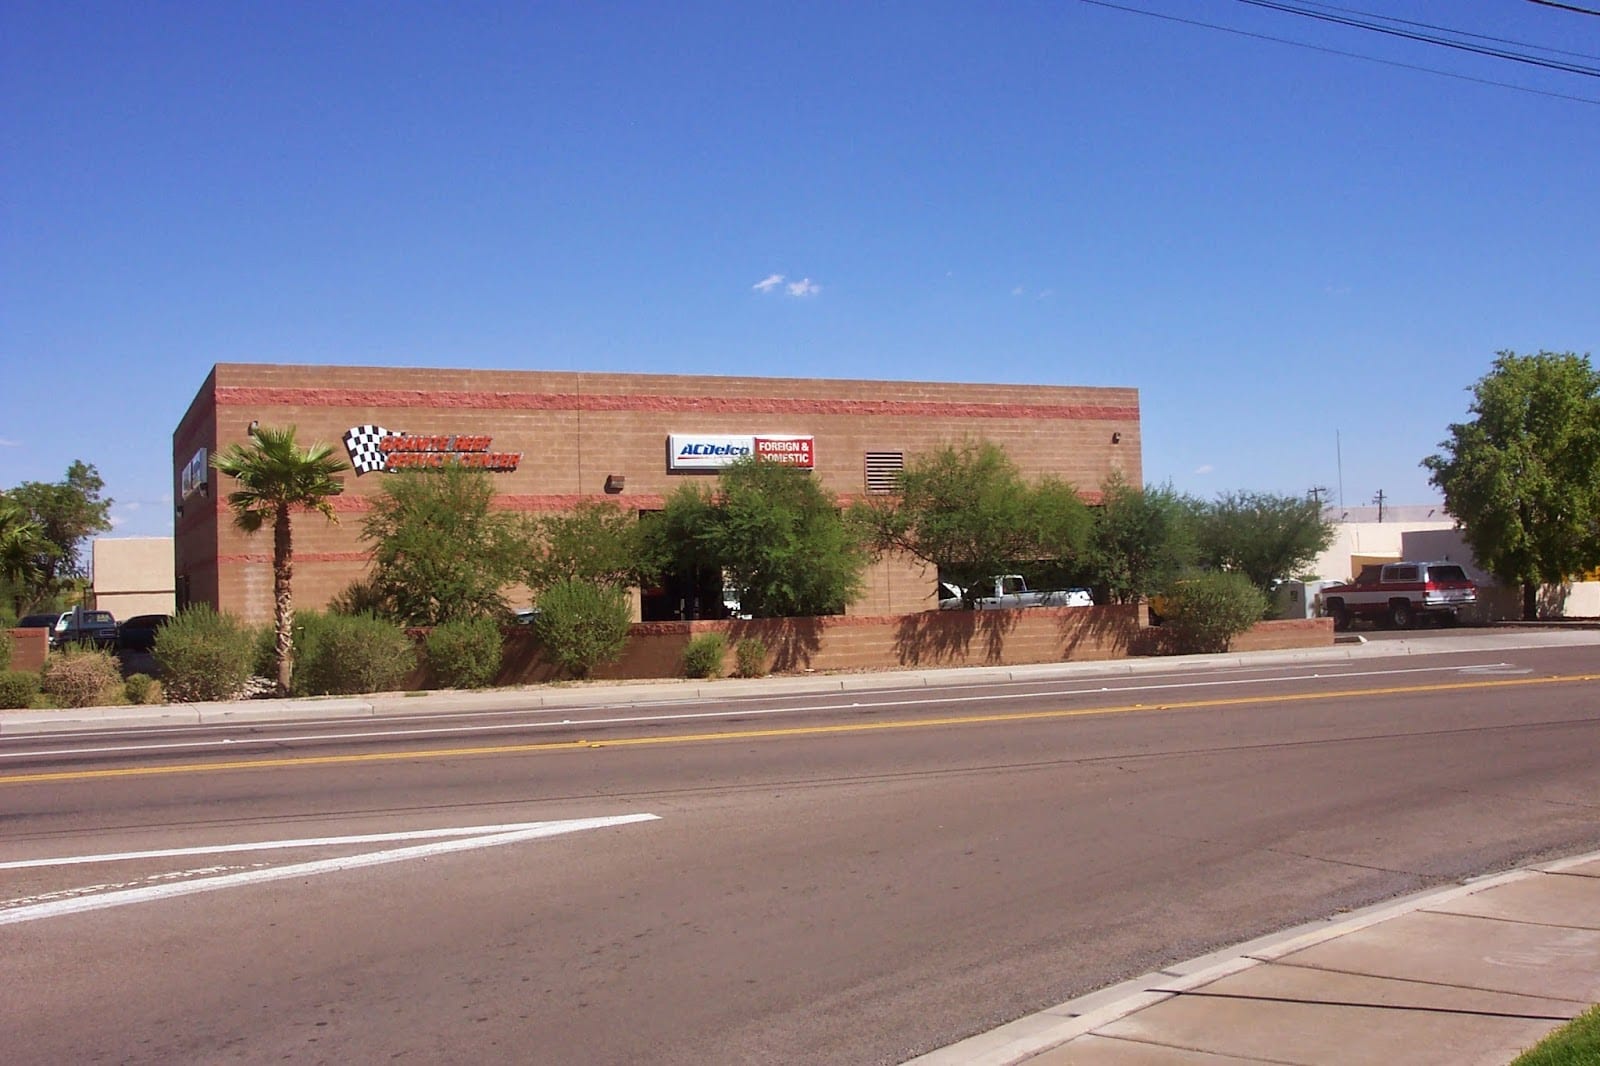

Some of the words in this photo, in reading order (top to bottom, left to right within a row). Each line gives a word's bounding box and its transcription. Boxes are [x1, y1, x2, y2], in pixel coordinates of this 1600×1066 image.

[680, 443, 750, 456] ACDelco
[759, 441, 799, 452] FOREIGN
[801, 442, 809, 452] &
